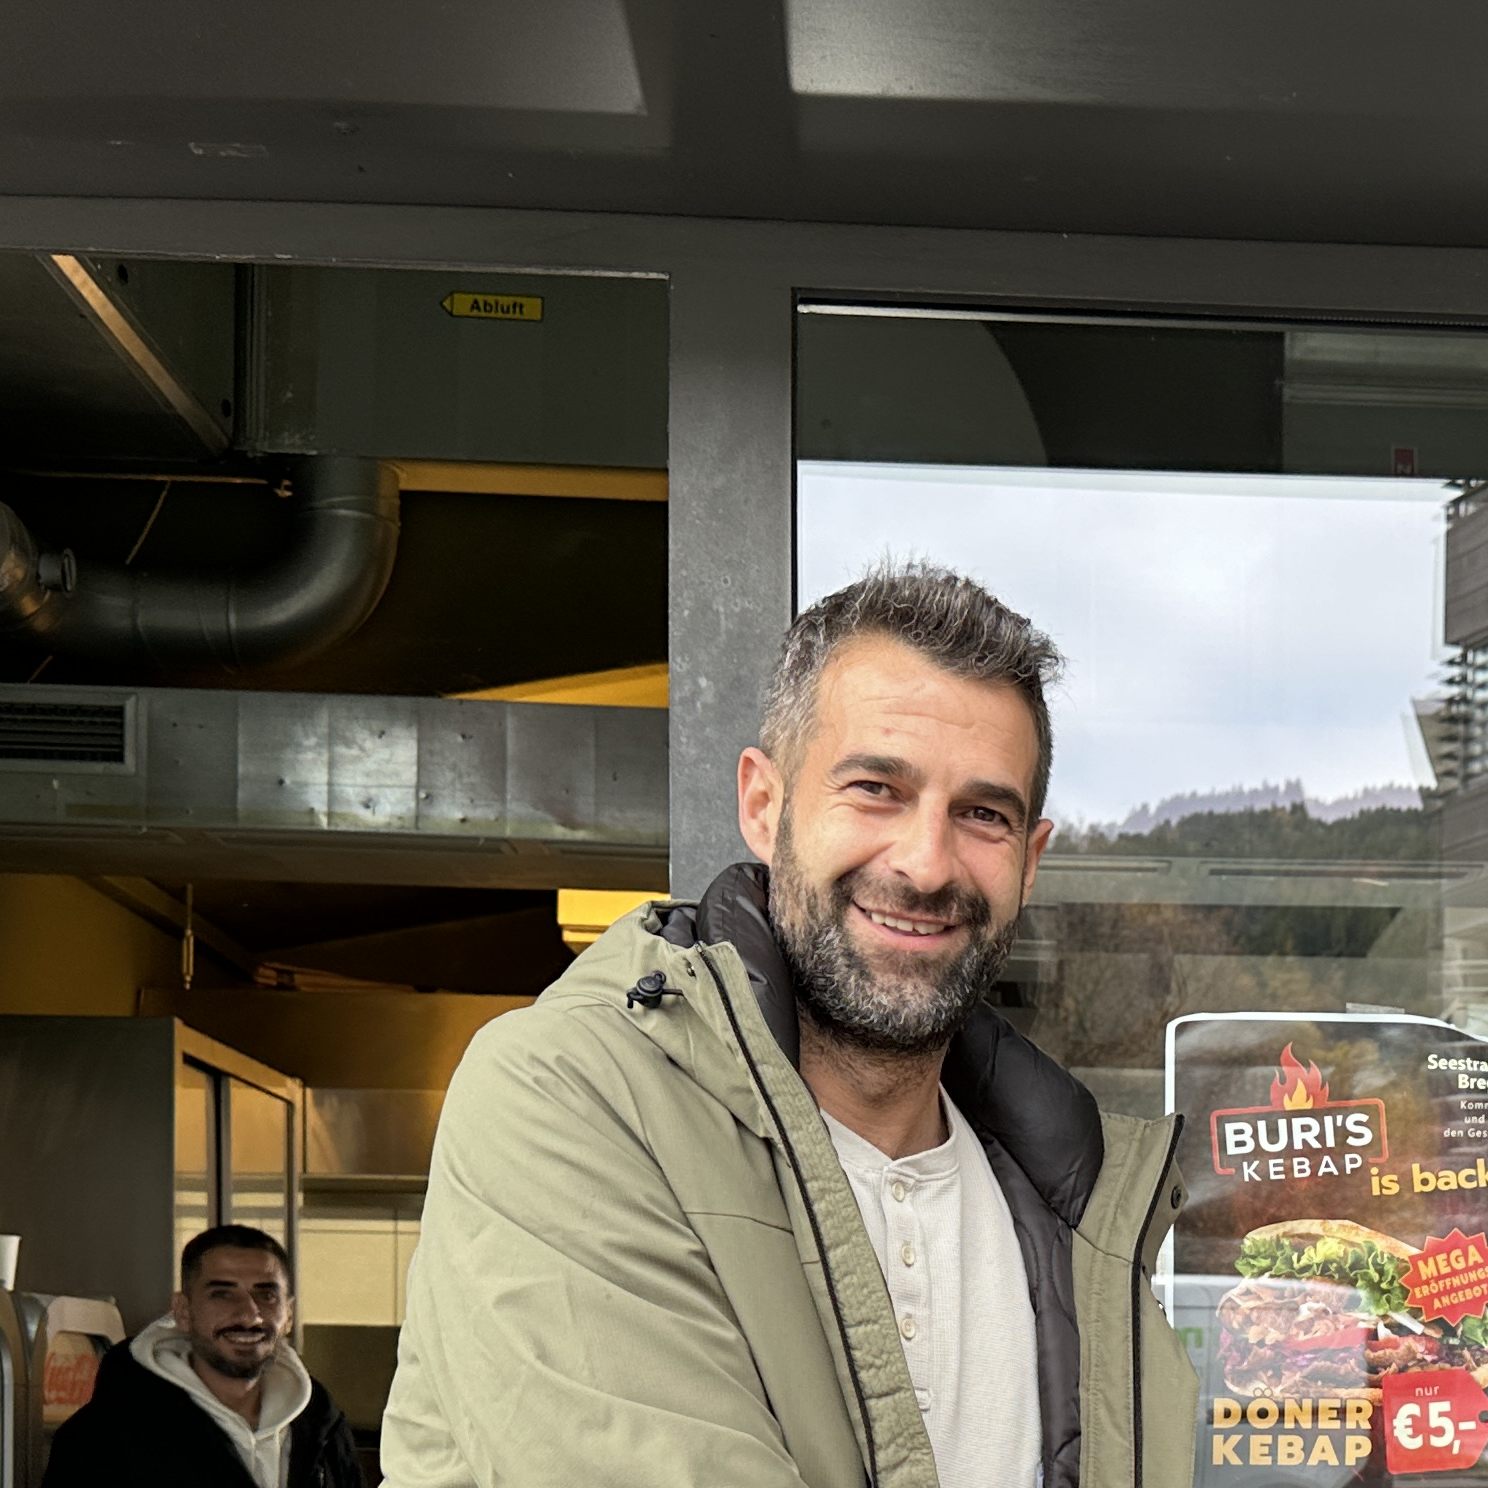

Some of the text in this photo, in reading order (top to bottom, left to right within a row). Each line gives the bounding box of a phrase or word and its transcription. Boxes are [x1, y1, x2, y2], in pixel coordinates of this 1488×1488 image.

[470, 298, 525, 315] Abluft
[1443, 1128, 1464, 1137] den
[1464, 1114, 1485, 1124] und
[1224, 1112, 1373, 1156] BURI'S
[1242, 1153, 1363, 1182] KEBAP
[1369, 1166, 1400, 1196] is
[1417, 1244, 1484, 1280] MEGA
[1433, 1283, 1488, 1311] ANGEBOT
[1415, 1385, 1440, 1397] nur
[1212, 1387, 1374, 1430] DÖNER
[1211, 1433, 1373, 1466] KEBAP
